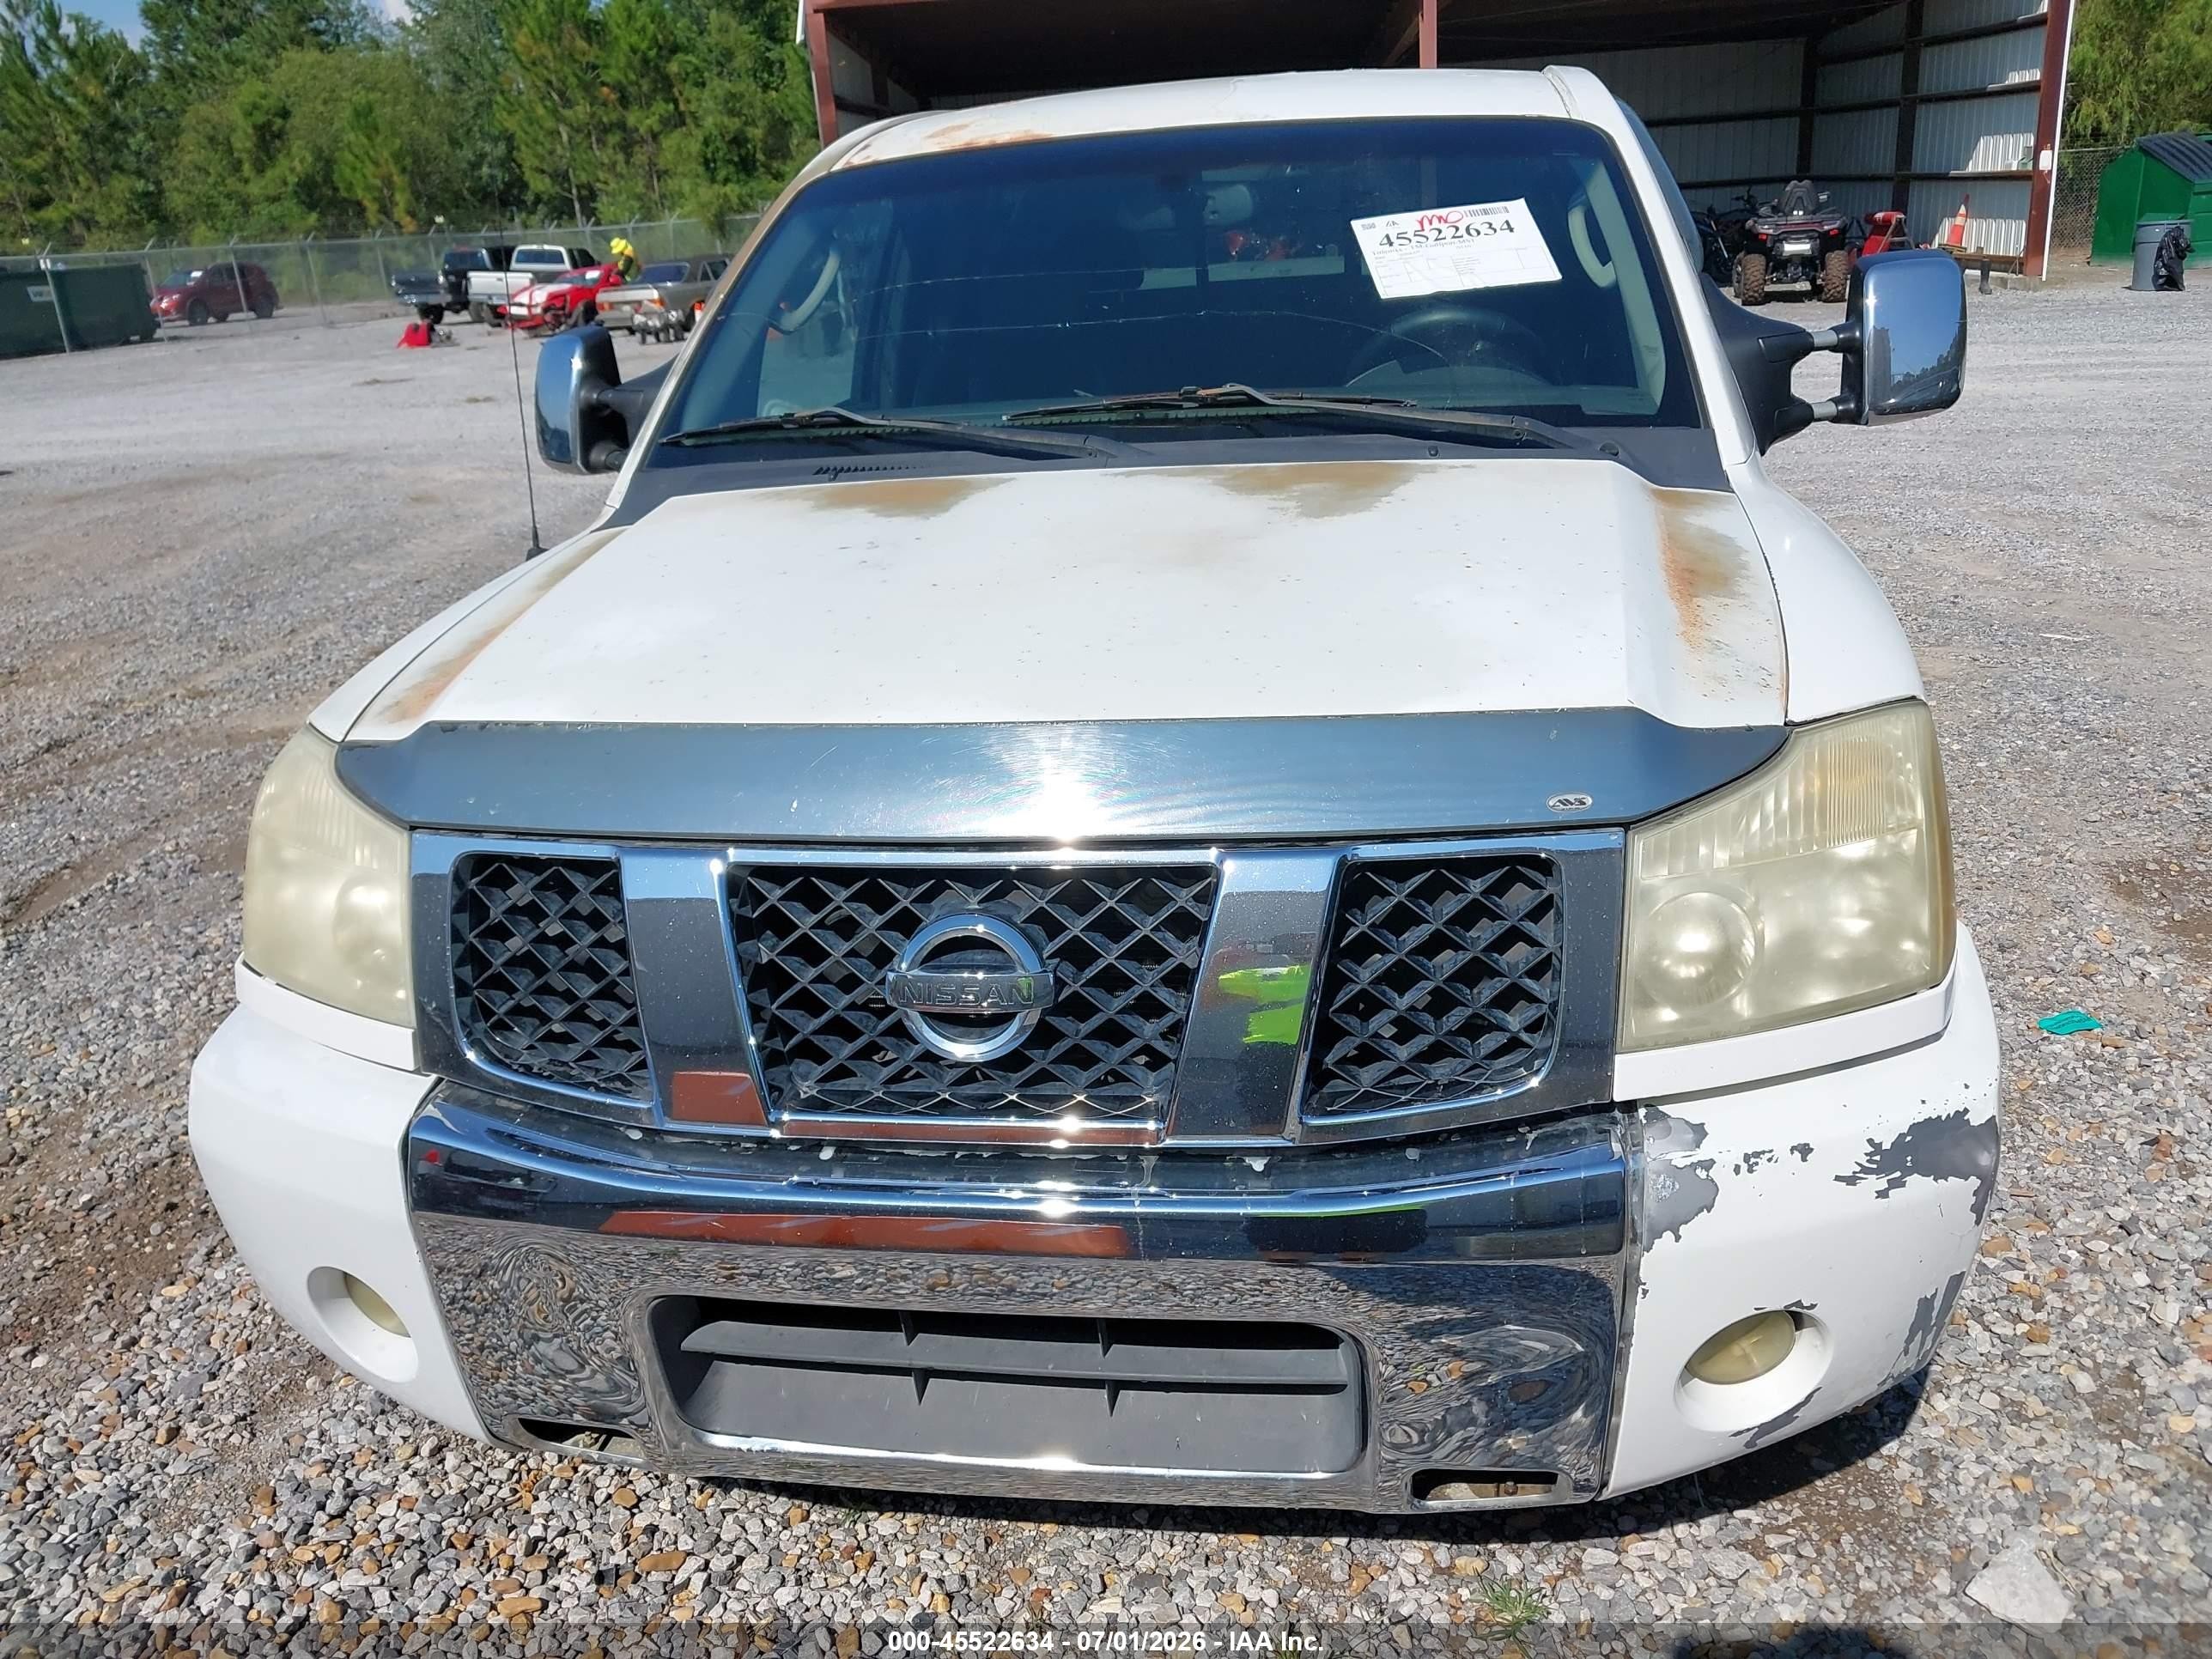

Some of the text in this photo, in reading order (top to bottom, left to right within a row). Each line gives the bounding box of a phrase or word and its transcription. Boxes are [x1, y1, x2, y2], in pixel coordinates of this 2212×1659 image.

[1378, 219, 1516, 247] 45522634
[1551, 797, 1588, 807] AVS
[900, 979, 1034, 1006] NISSAN
